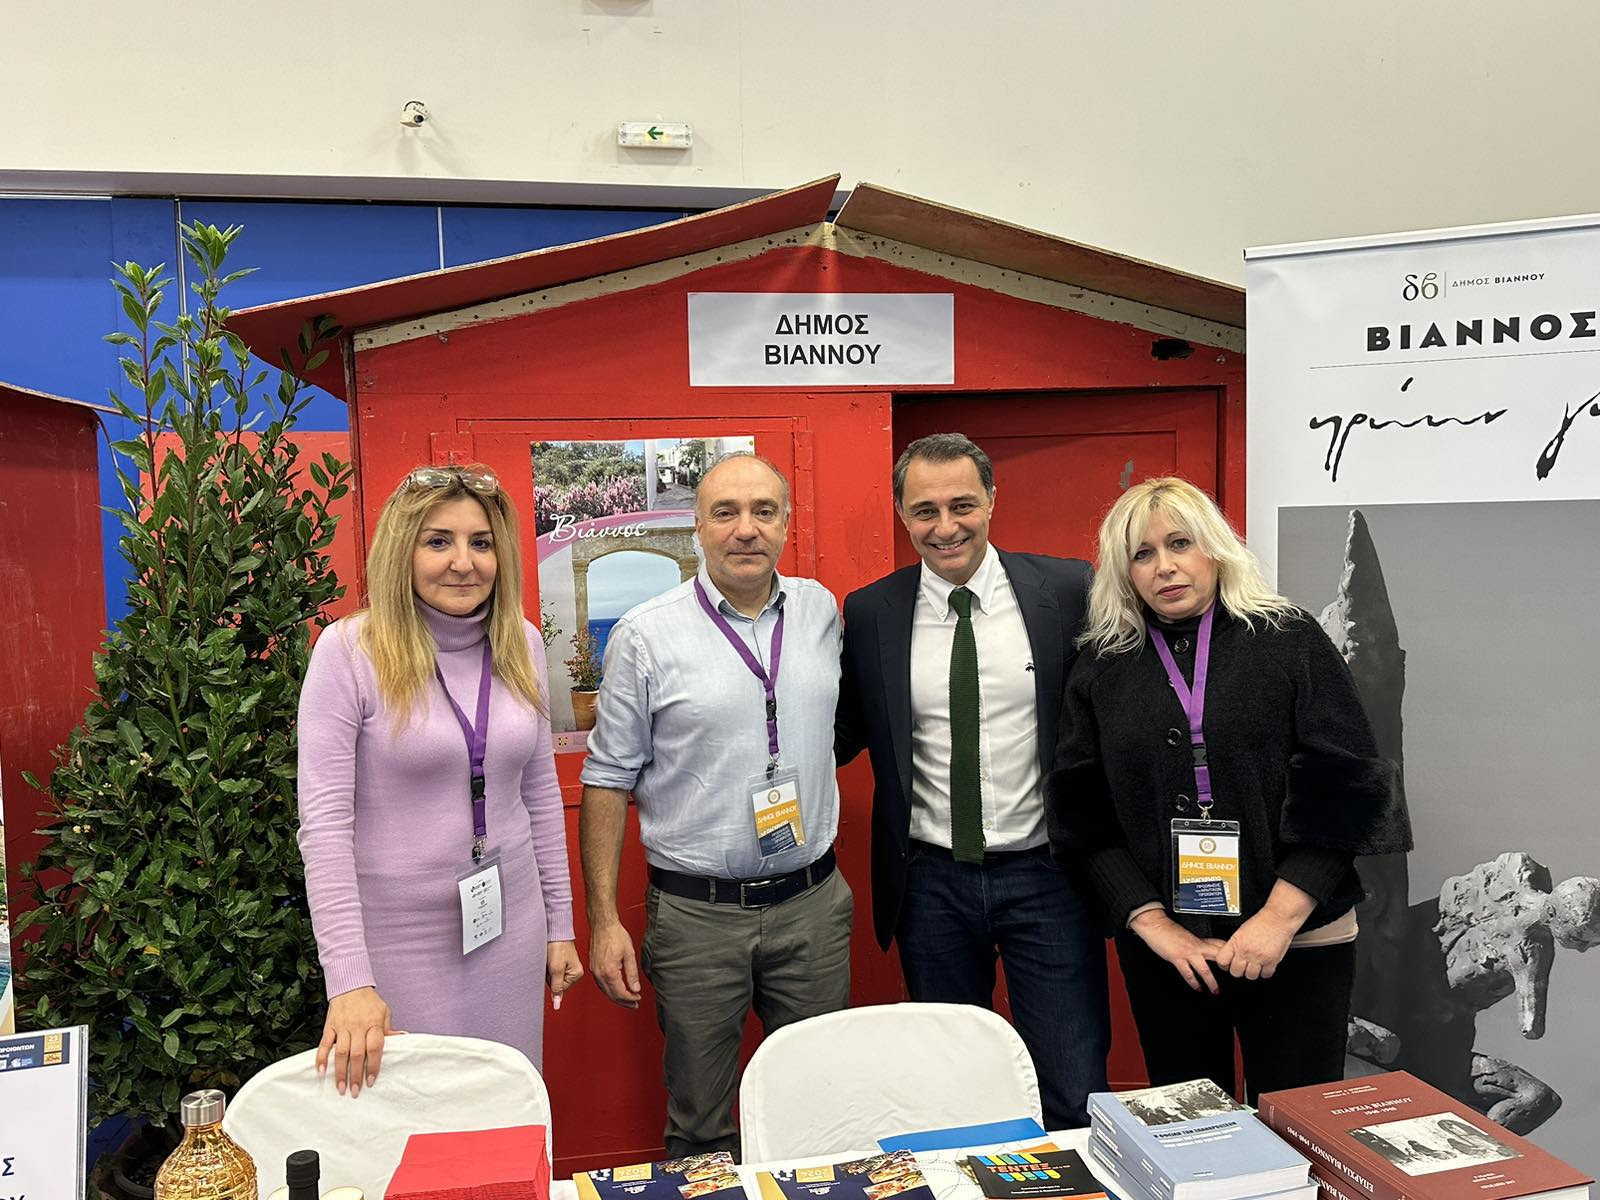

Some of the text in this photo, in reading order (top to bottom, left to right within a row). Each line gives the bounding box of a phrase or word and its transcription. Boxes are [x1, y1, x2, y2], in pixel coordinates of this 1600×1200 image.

[1451, 273, 1545, 287] ΔΗΜΟΣ ΒΙΑΝΝΟΥ
[775, 314, 869, 335] ΔΗΜΟΣ
[1366, 310, 1597, 352] ΒΙΑΝΝΟΣ
[764, 344, 882, 365] ΒΙΑΝΝΟΥ
[1311, 1143, 1342, 1170] ΒΙΑΝΝΟΥ
[1342, 1164, 1374, 1192] ΕΠΑΡΧΙΑ
